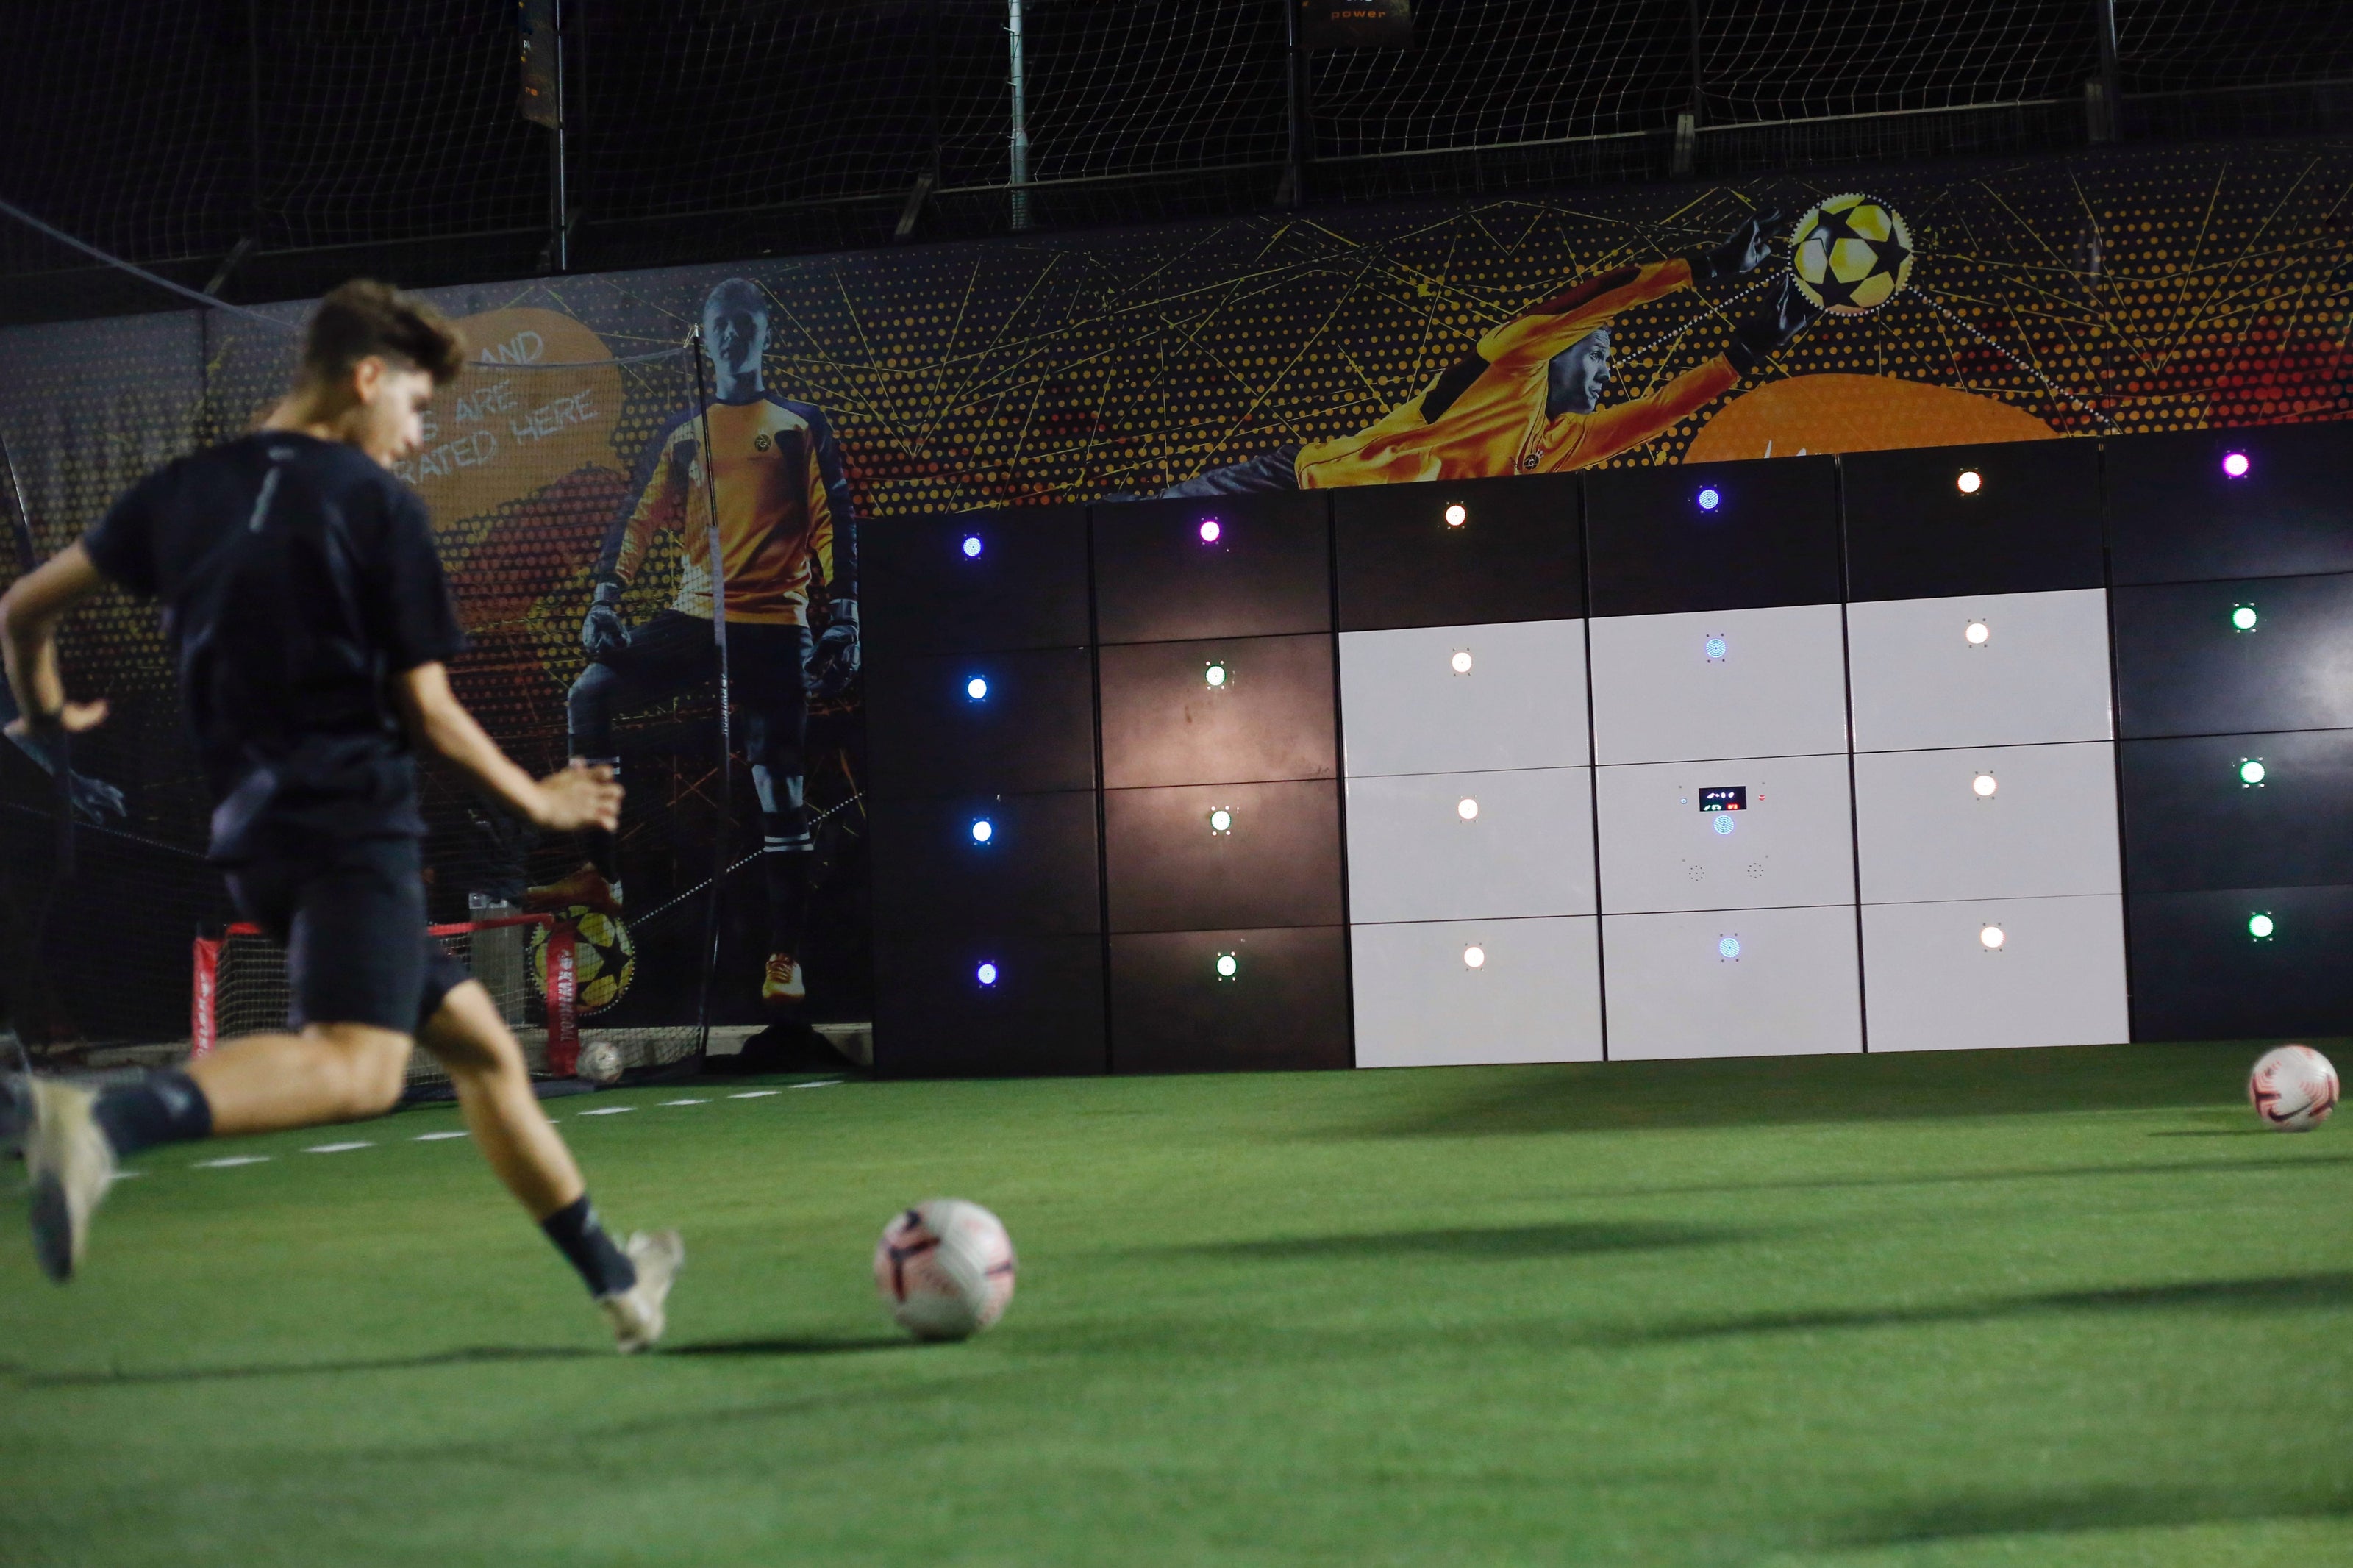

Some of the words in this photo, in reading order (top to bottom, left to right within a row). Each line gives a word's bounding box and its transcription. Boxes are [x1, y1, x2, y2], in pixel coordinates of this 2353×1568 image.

[1331, 10, 1386, 20] power
[479, 330, 543, 370] AND
[455, 379, 518, 422] ARE
[510, 389, 600, 445] HERE
